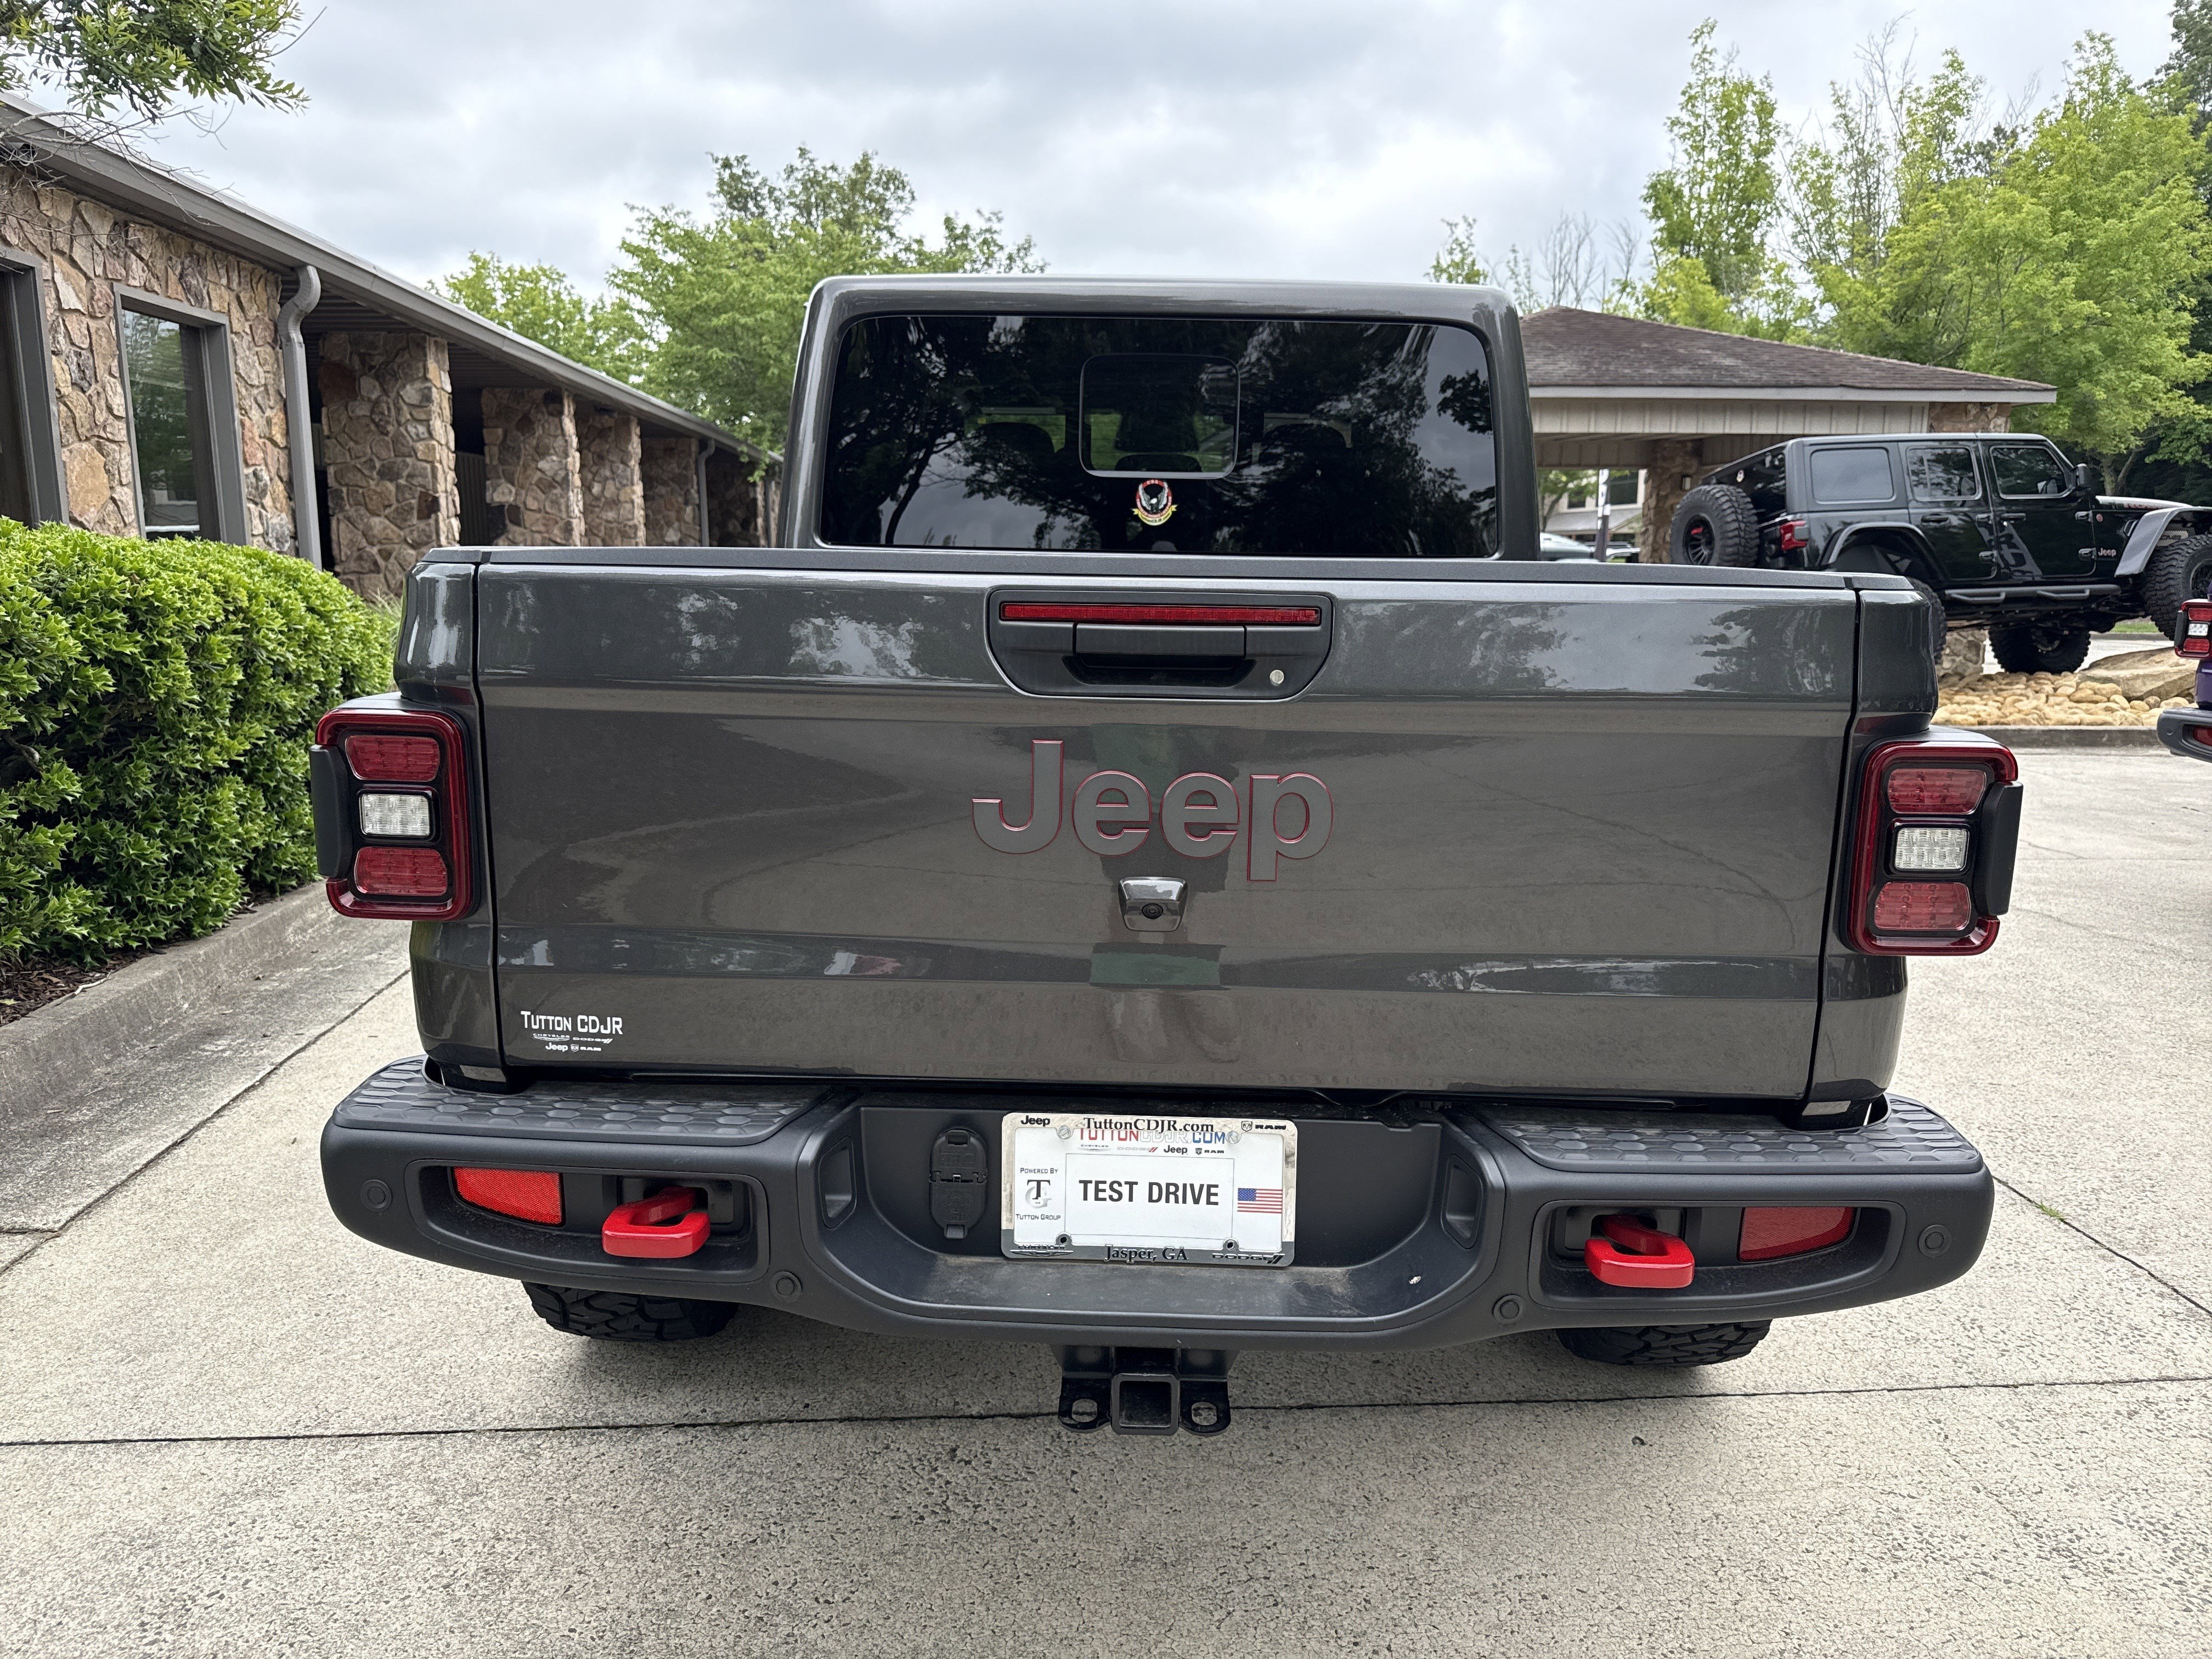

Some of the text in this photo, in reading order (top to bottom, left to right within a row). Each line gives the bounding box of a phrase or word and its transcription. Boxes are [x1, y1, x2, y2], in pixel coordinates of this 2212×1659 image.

[2098, 548, 2117, 557] Jeep
[972, 739, 1334, 882] Jeep
[521, 1011, 623, 1035] TUTTON CDJR
[545, 1042, 568, 1052] Jeep
[1020, 1115, 1051, 1127] Jeep
[1083, 1117, 1215, 1134] TuttonCDJR.com
[1164, 1145, 1188, 1155] Jeep
[1079, 1180, 1219, 1205] TEST DRIVE
[1104, 1244, 1189, 1263] Jasper, GA
[1212, 1252, 1275, 1261] DODGE
